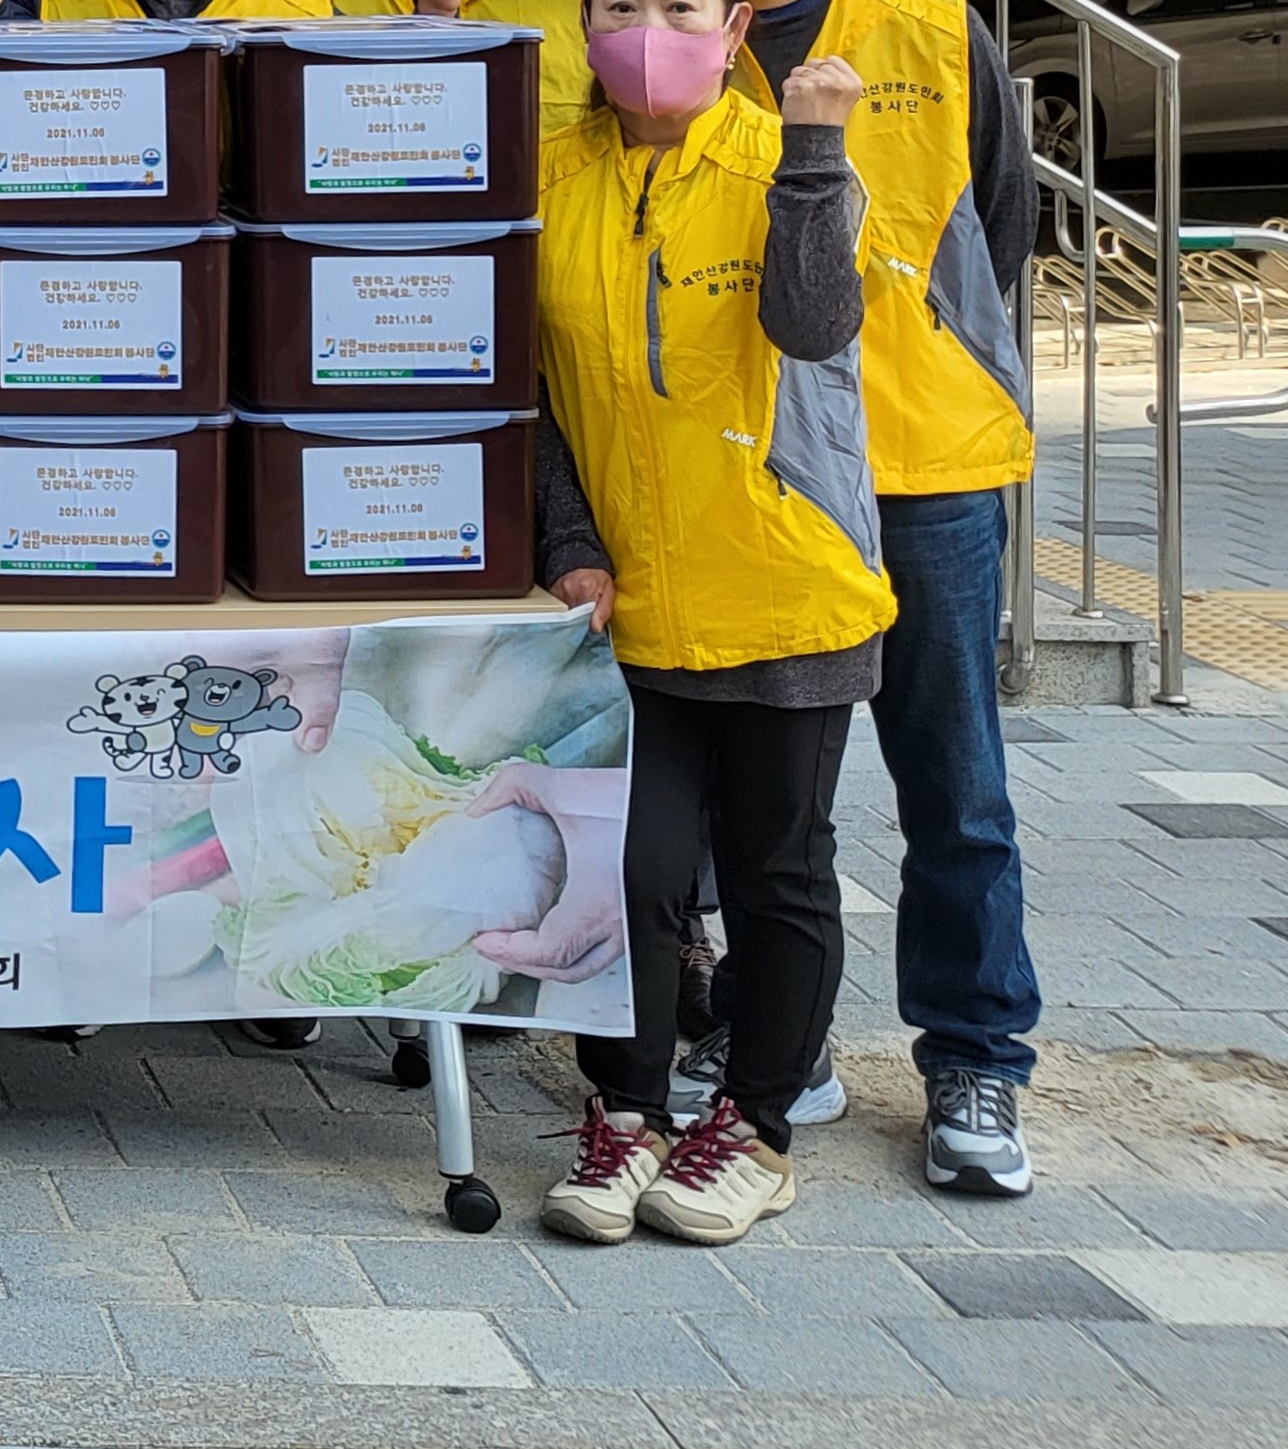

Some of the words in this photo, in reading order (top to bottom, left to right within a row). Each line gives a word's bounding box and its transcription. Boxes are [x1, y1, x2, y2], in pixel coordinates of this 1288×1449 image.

[869, 99, 919, 114] 봉사단
[887, 257, 919, 278] MARK
[707, 277, 755, 296] 봉사단
[721, 427, 757, 448] MARK
